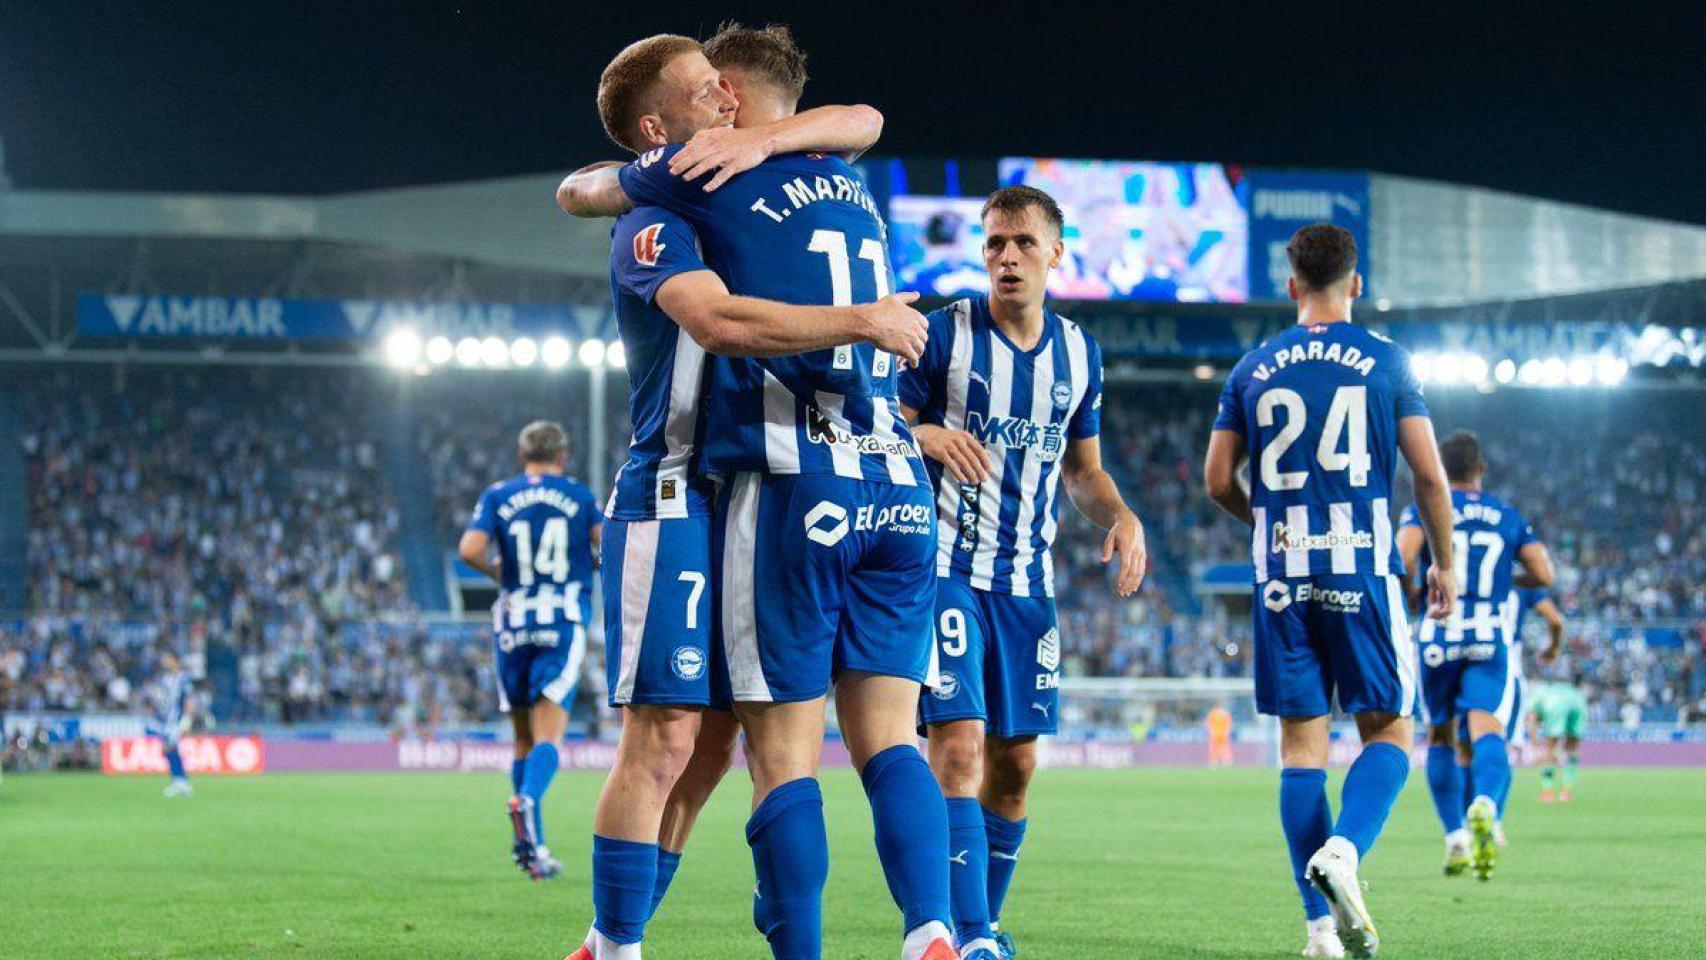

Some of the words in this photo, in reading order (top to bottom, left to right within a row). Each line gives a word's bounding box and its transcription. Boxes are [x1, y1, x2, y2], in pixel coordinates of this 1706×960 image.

[139, 299, 287, 337] AMBAR
[807, 229, 889, 377] 11
[1252, 341, 1376, 382] V.PARADA
[1256, 385, 1371, 490] 24
[509, 517, 570, 587] 14
[1273, 524, 1373, 553] Kutxabank
[1452, 529, 1505, 598] 17
[677, 570, 706, 630] 7
[940, 608, 968, 657] 9
[108, 737, 222, 772] LALGA
